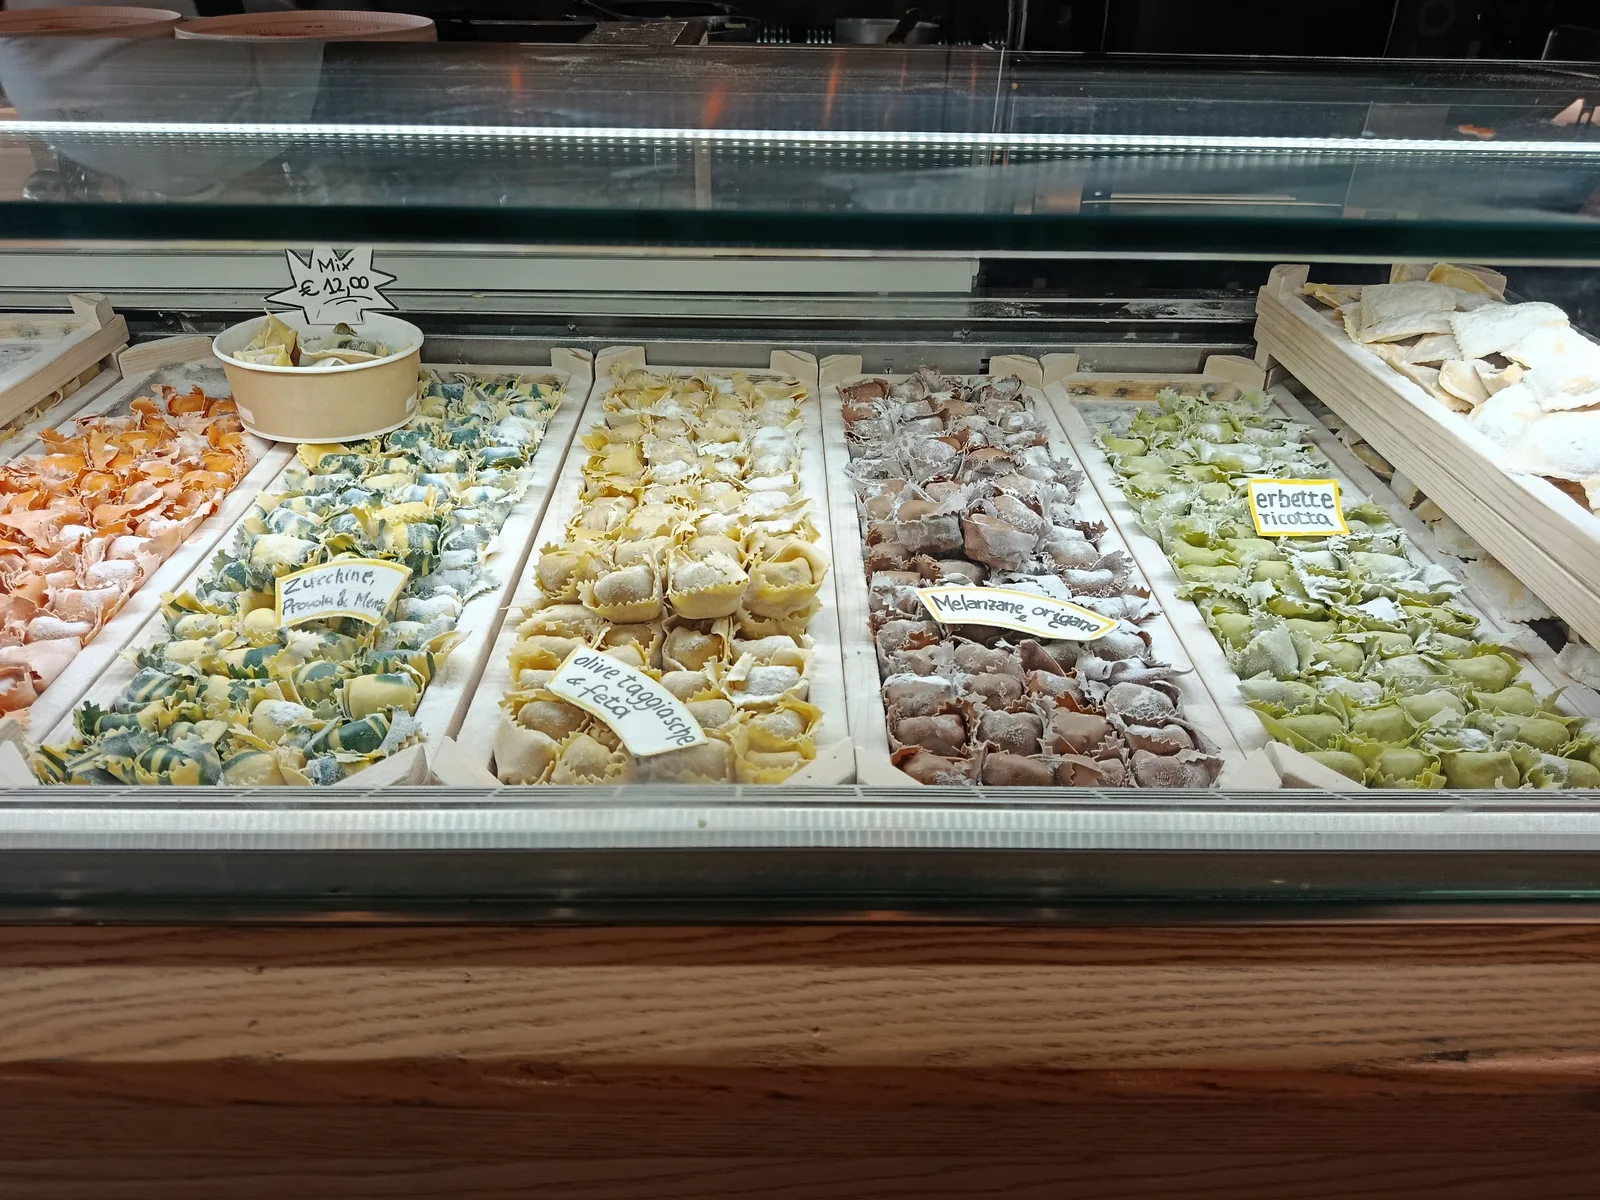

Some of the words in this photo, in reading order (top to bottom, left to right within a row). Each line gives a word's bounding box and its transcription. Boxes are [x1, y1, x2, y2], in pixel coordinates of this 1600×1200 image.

[316, 257, 355, 274] Mix
[298, 279, 320, 297] €
[322, 275, 370, 298] 12,00
[1256, 489, 1335, 509] erbette
[1258, 511, 1334, 527] ricotta
[283, 567, 375, 596] Zucchine,
[336, 588, 348, 608] &
[930, 594, 1025, 614] Melanzane
[1014, 614, 1028, 623] e
[1031, 608, 1101, 633] origano
[565, 677, 587, 687] &
[577, 684, 632, 720] feta
[573, 655, 621, 681] olive
[616, 674, 696, 747] taggiasche
